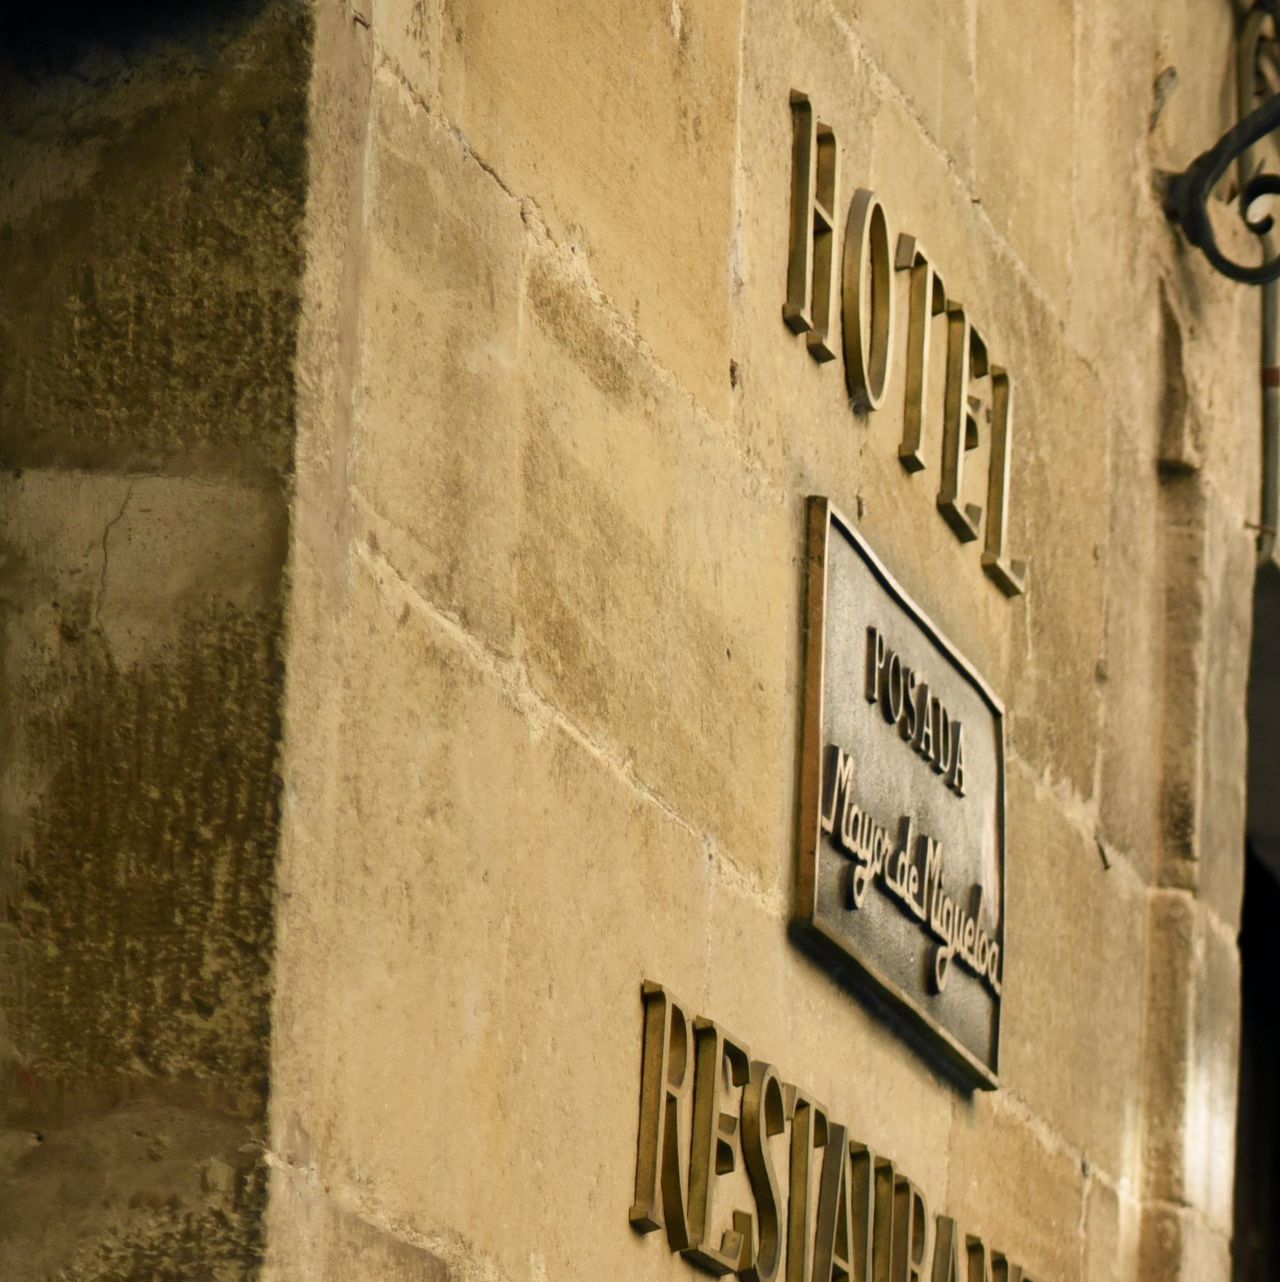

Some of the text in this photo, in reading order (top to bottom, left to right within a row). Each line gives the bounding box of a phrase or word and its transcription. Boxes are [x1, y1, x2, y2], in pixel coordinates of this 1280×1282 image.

[783, 88, 1027, 598] HOTEL
[866, 625, 966, 798] POSADA
[821, 743, 893, 910] Mayor
